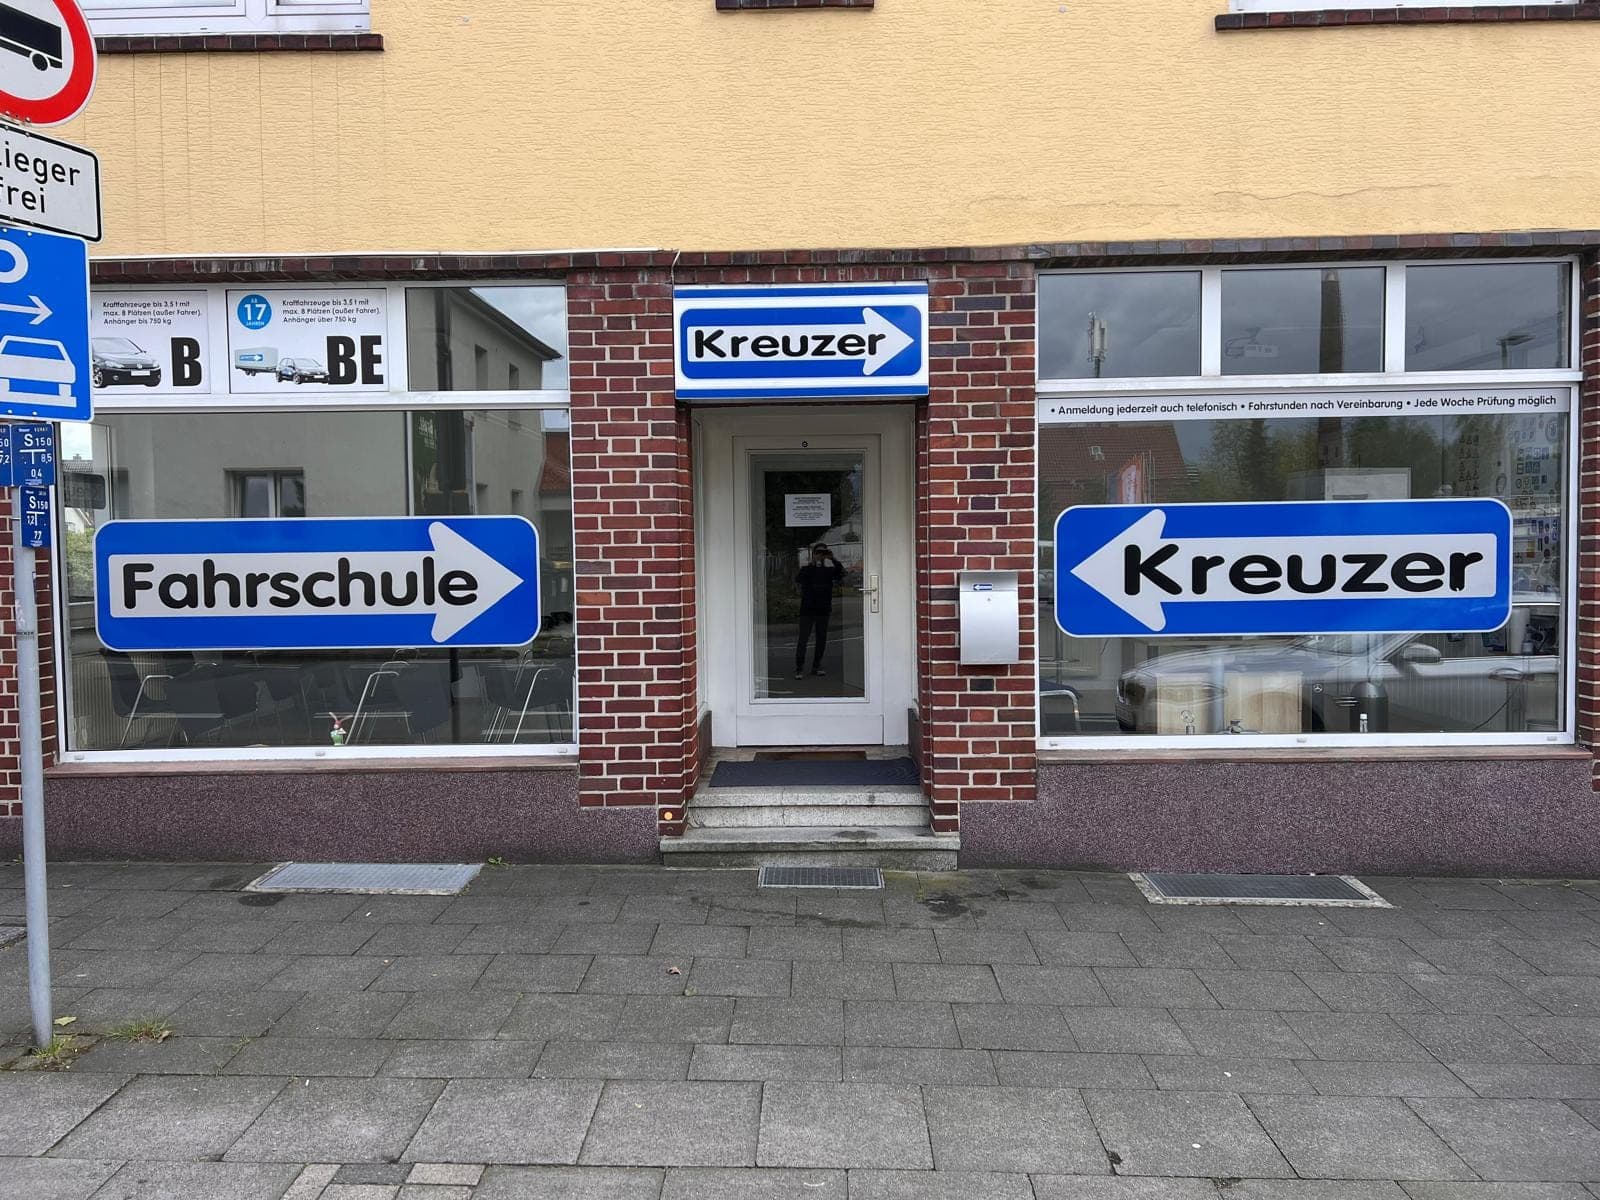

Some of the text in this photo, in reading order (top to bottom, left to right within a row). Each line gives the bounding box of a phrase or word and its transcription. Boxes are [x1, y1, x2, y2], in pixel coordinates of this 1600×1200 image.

[0, 141, 80, 185] ieger
[104, 318, 137, 326] Anhänger
[162, 317, 172, 326] kg
[244, 303, 267, 321] 17
[283, 316, 316, 324] Anhänger
[347, 316, 357, 324] kg
[171, 337, 203, 387] B
[327, 335, 384, 386] BE
[695, 329, 886, 359] Kreuzer
[1058, 395, 1557, 416] Anmeldung jederzeit auch telefonisch Fahrstunden nach Vereinbarung Jede Woche Prüfung möglich
[122, 556, 478, 610] Fahrschule
[1124, 543, 1483, 597] Kreuzer
